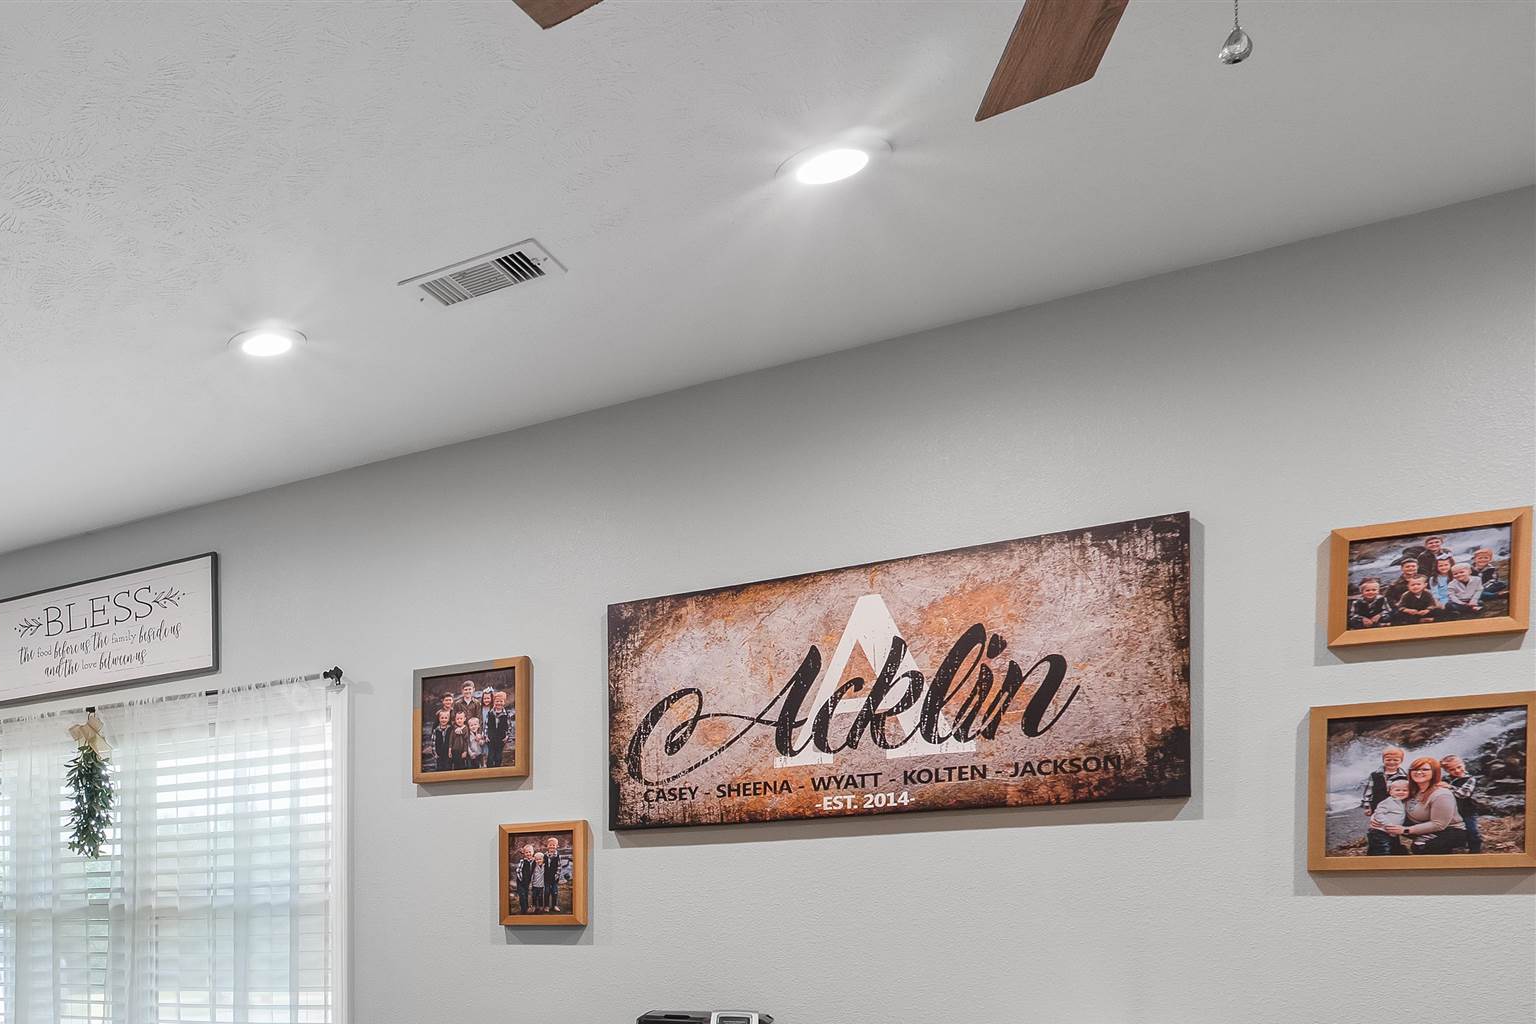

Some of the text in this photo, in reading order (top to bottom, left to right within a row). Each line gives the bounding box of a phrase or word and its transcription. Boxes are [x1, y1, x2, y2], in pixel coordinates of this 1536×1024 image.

[43, 585, 154, 637] BLESS
[17, 646, 35, 665] the
[37, 645, 52, 658] food
[53, 640, 80, 659] before
[90, 631, 109, 651] the
[111, 630, 137, 644] family
[138, 619, 170, 644] beside
[170, 622, 182, 639] us
[44, 648, 147, 678] and the love between us
[626, 622, 1081, 787] Acklin
[643, 753, 1123, 803] CASEY SHEENA WYATT KOLTEN JACKSON
